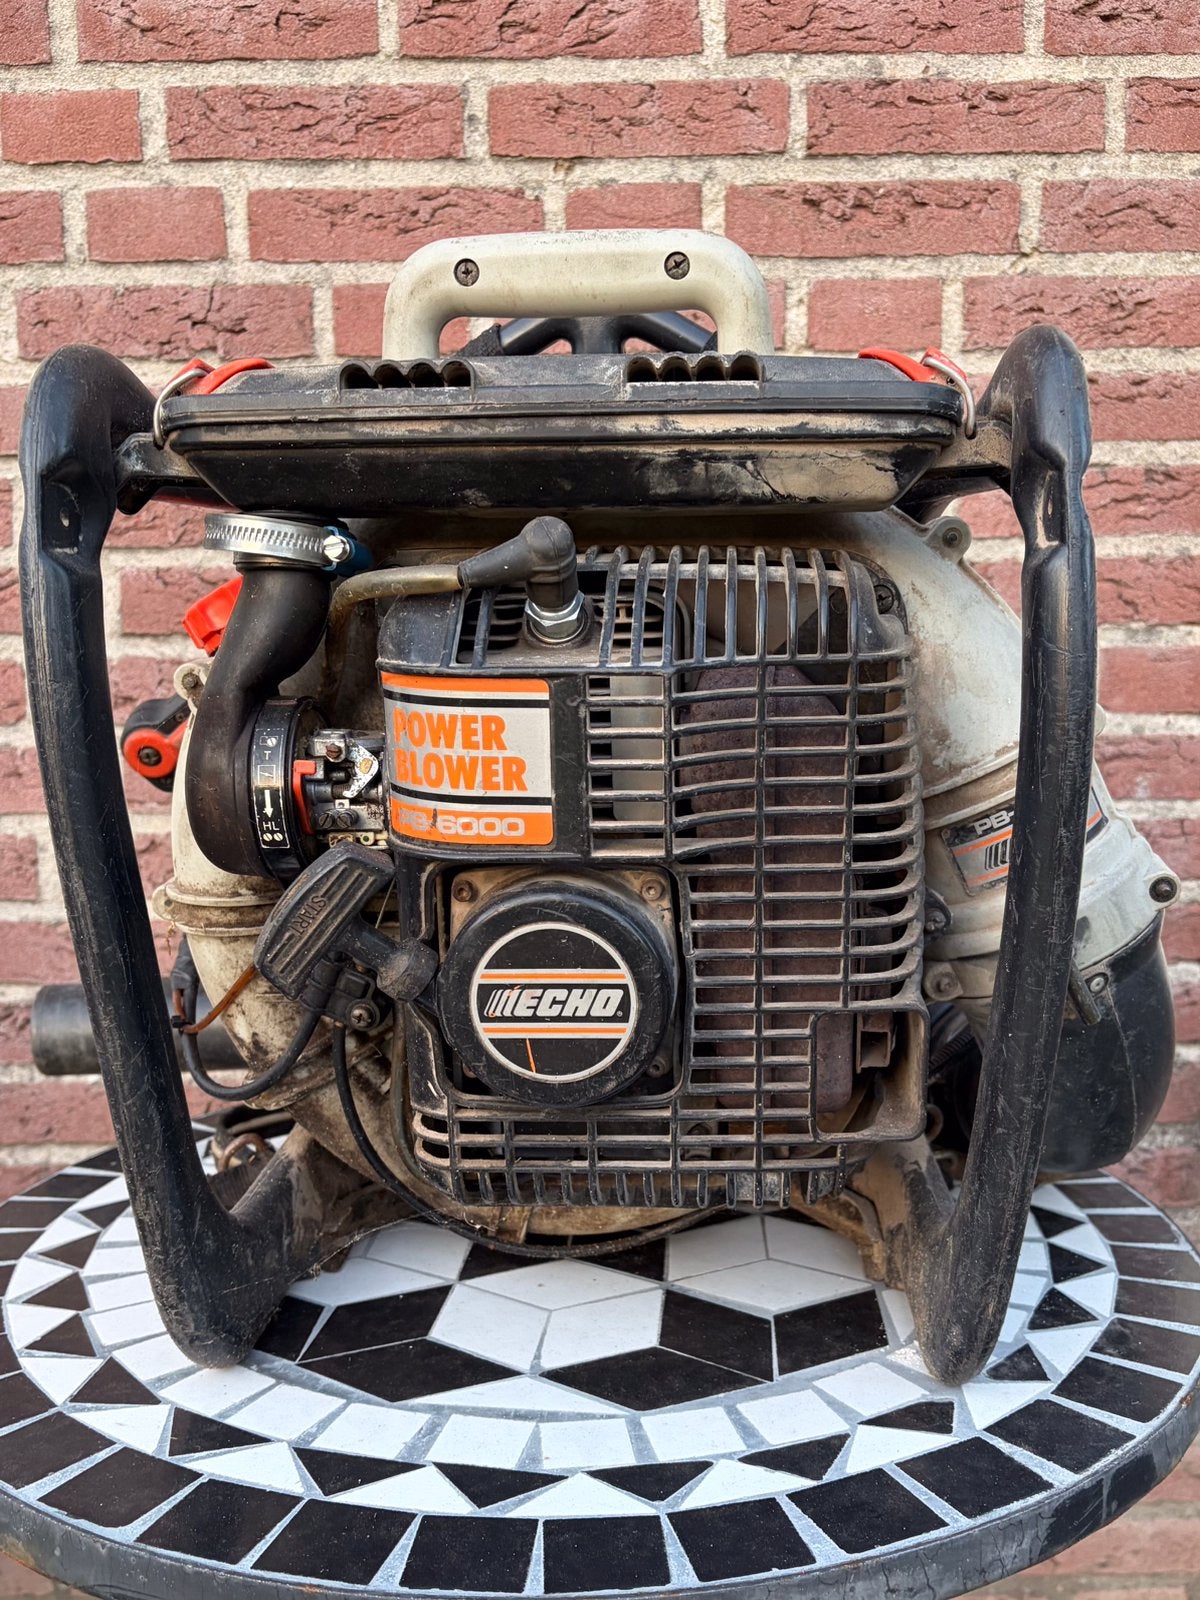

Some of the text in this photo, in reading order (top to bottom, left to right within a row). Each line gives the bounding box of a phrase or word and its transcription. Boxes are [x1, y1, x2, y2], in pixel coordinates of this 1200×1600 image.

[393, 708, 508, 751] POWER
[264, 750, 272, 760] T
[394, 748, 528, 792] BLOWER
[290, 894, 327, 937] START
[512, 988, 624, 1017] ECHO
